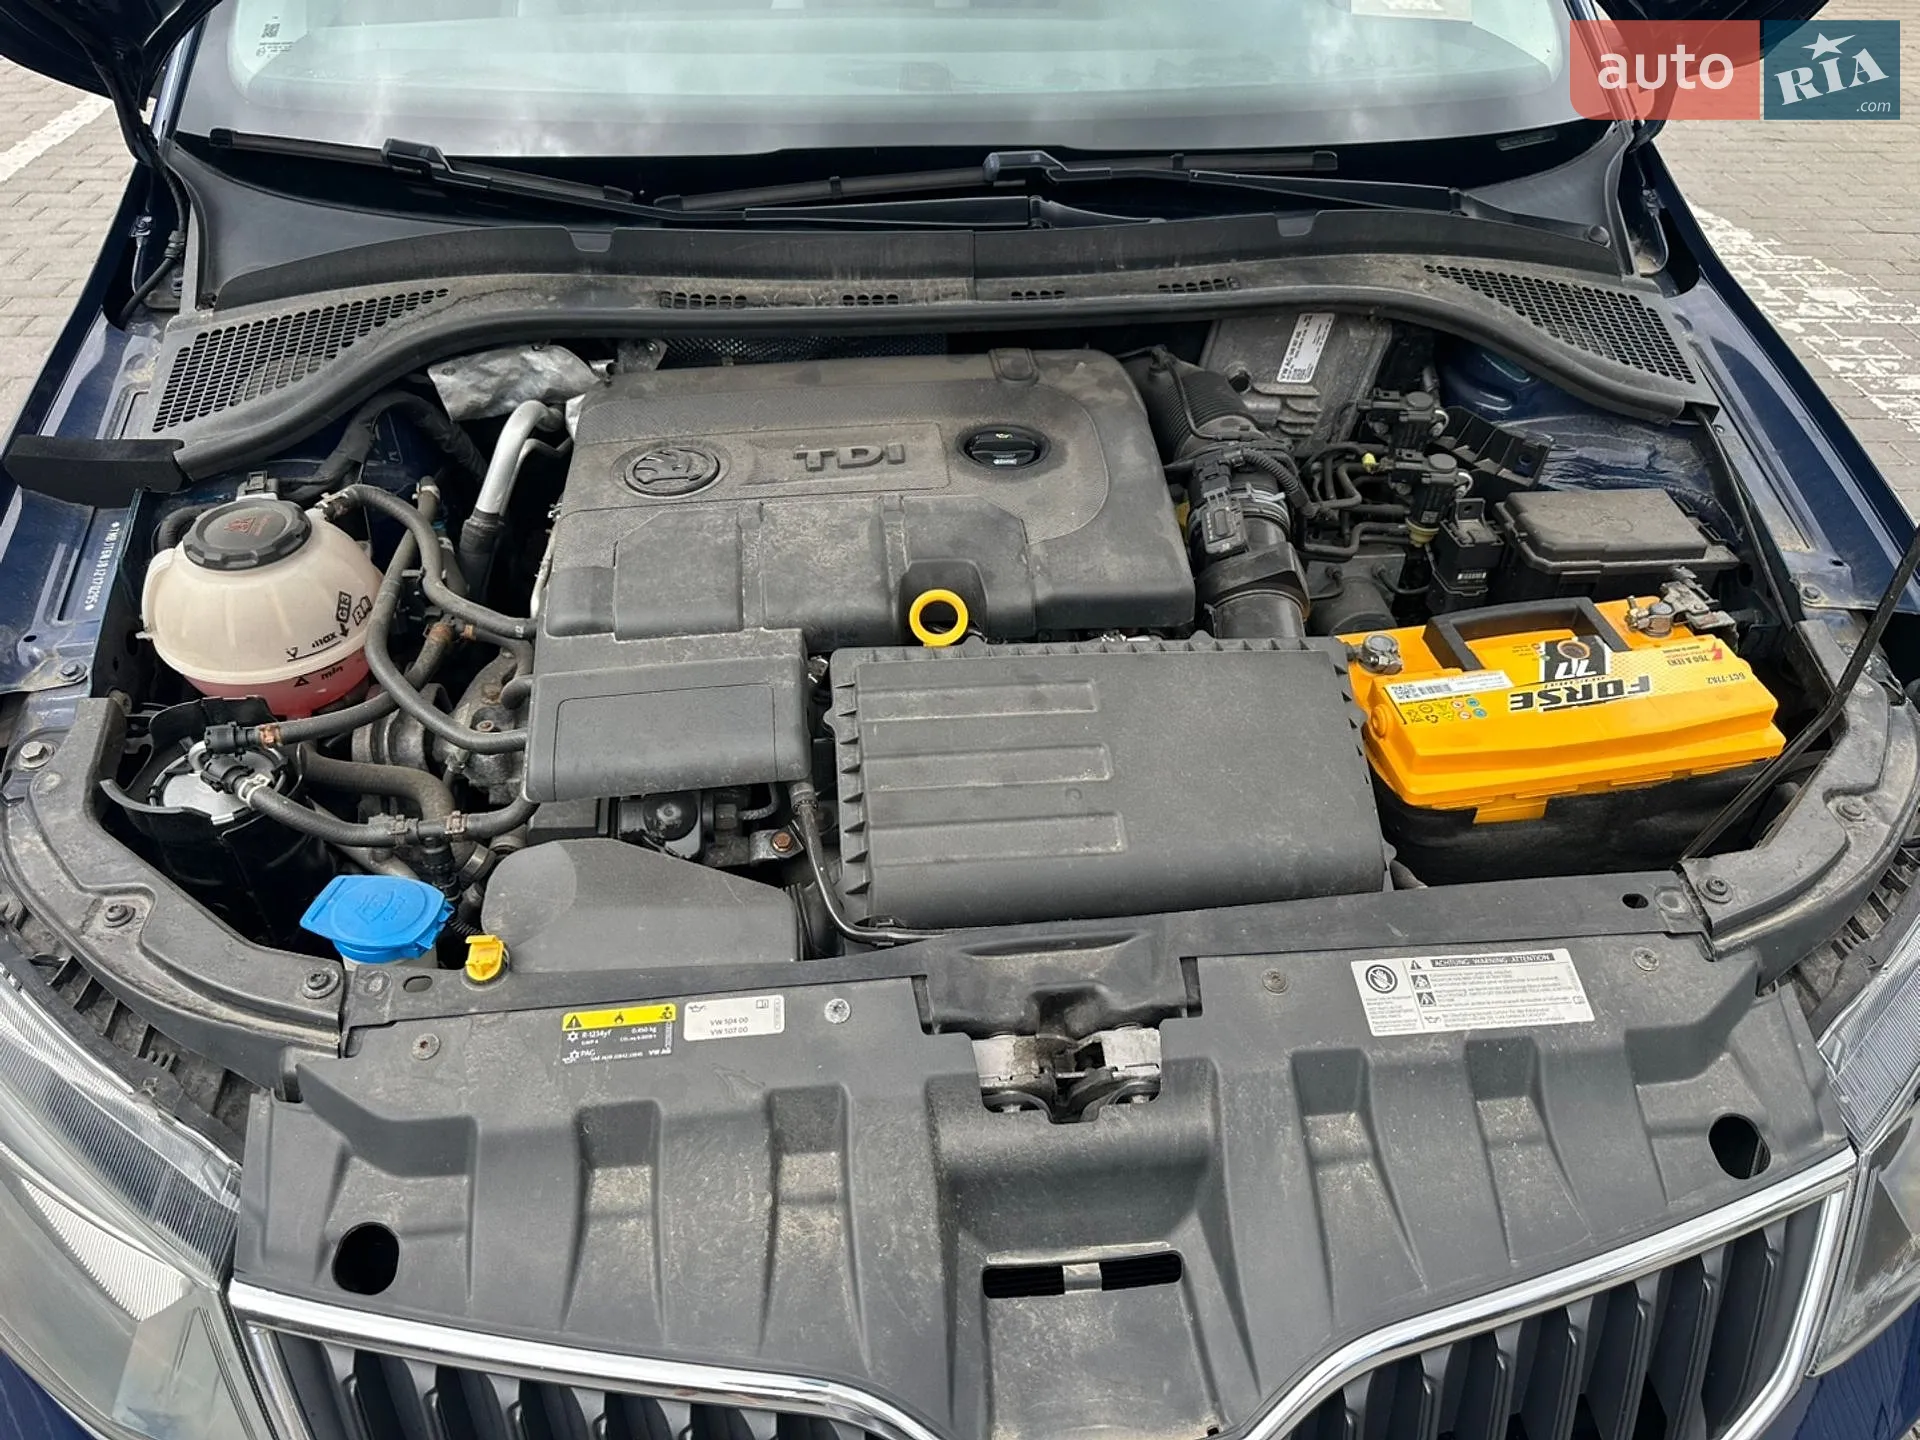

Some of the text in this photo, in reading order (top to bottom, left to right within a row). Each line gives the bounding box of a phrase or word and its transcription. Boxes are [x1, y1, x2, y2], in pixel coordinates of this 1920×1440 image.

[794, 443, 905, 473] TDI
[311, 632, 338, 648] max
[321, 666, 344, 680] min
[1510, 675, 1650, 712] FORSE
